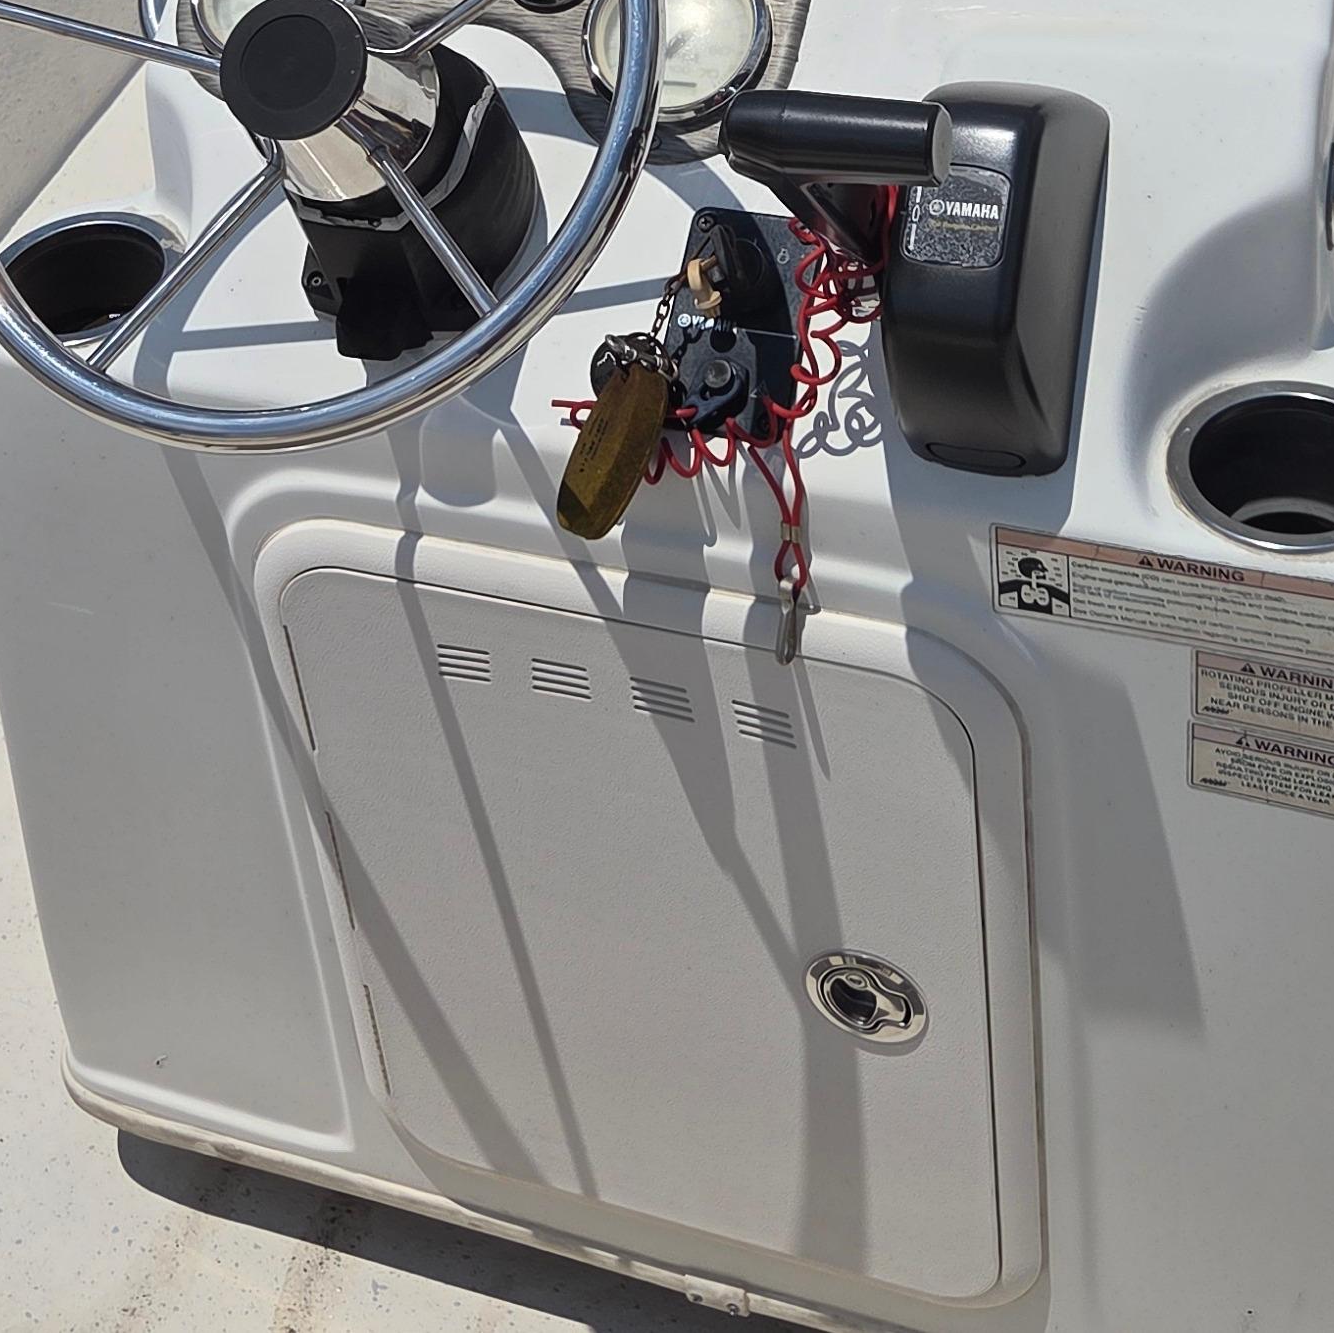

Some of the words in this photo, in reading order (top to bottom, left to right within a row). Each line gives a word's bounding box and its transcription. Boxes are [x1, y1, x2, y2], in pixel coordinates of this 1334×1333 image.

[946, 200, 999, 219] YAMAHA
[1156, 557, 1245, 581] WARNING
[1200, 667, 1254, 686] ROTATING
[1256, 679, 1322, 700] PROPELLER
[1218, 680, 1266, 698] SERIOUS
[1268, 690, 1307, 706] INJURY
[1310, 699, 1327, 710] OR
[1210, 695, 1240, 710] NEAR
[1242, 702, 1295, 721] PERSONS
[1297, 713, 1308, 724] IN
[1311, 716, 1333, 729] THE
[1227, 690, 1254, 704] SHUT
[1258, 697, 1280, 709] OFF
[1282, 702, 1323, 718] ENGINE
[1214, 747, 1241, 759] AVOID
[1242, 753, 1281, 768] SERIOUS
[1316, 768, 1330, 778] OR
[1278, 767, 1292, 776] OR
[1240, 779, 1268, 792] LEAST
[1270, 786, 1295, 798] ONCE
[1256, 776, 1291, 790] SYSTEM
[1293, 784, 1312, 795] FOR
[1265, 771, 1291, 783] FROM
[1292, 777, 1331, 792] LEAKING
